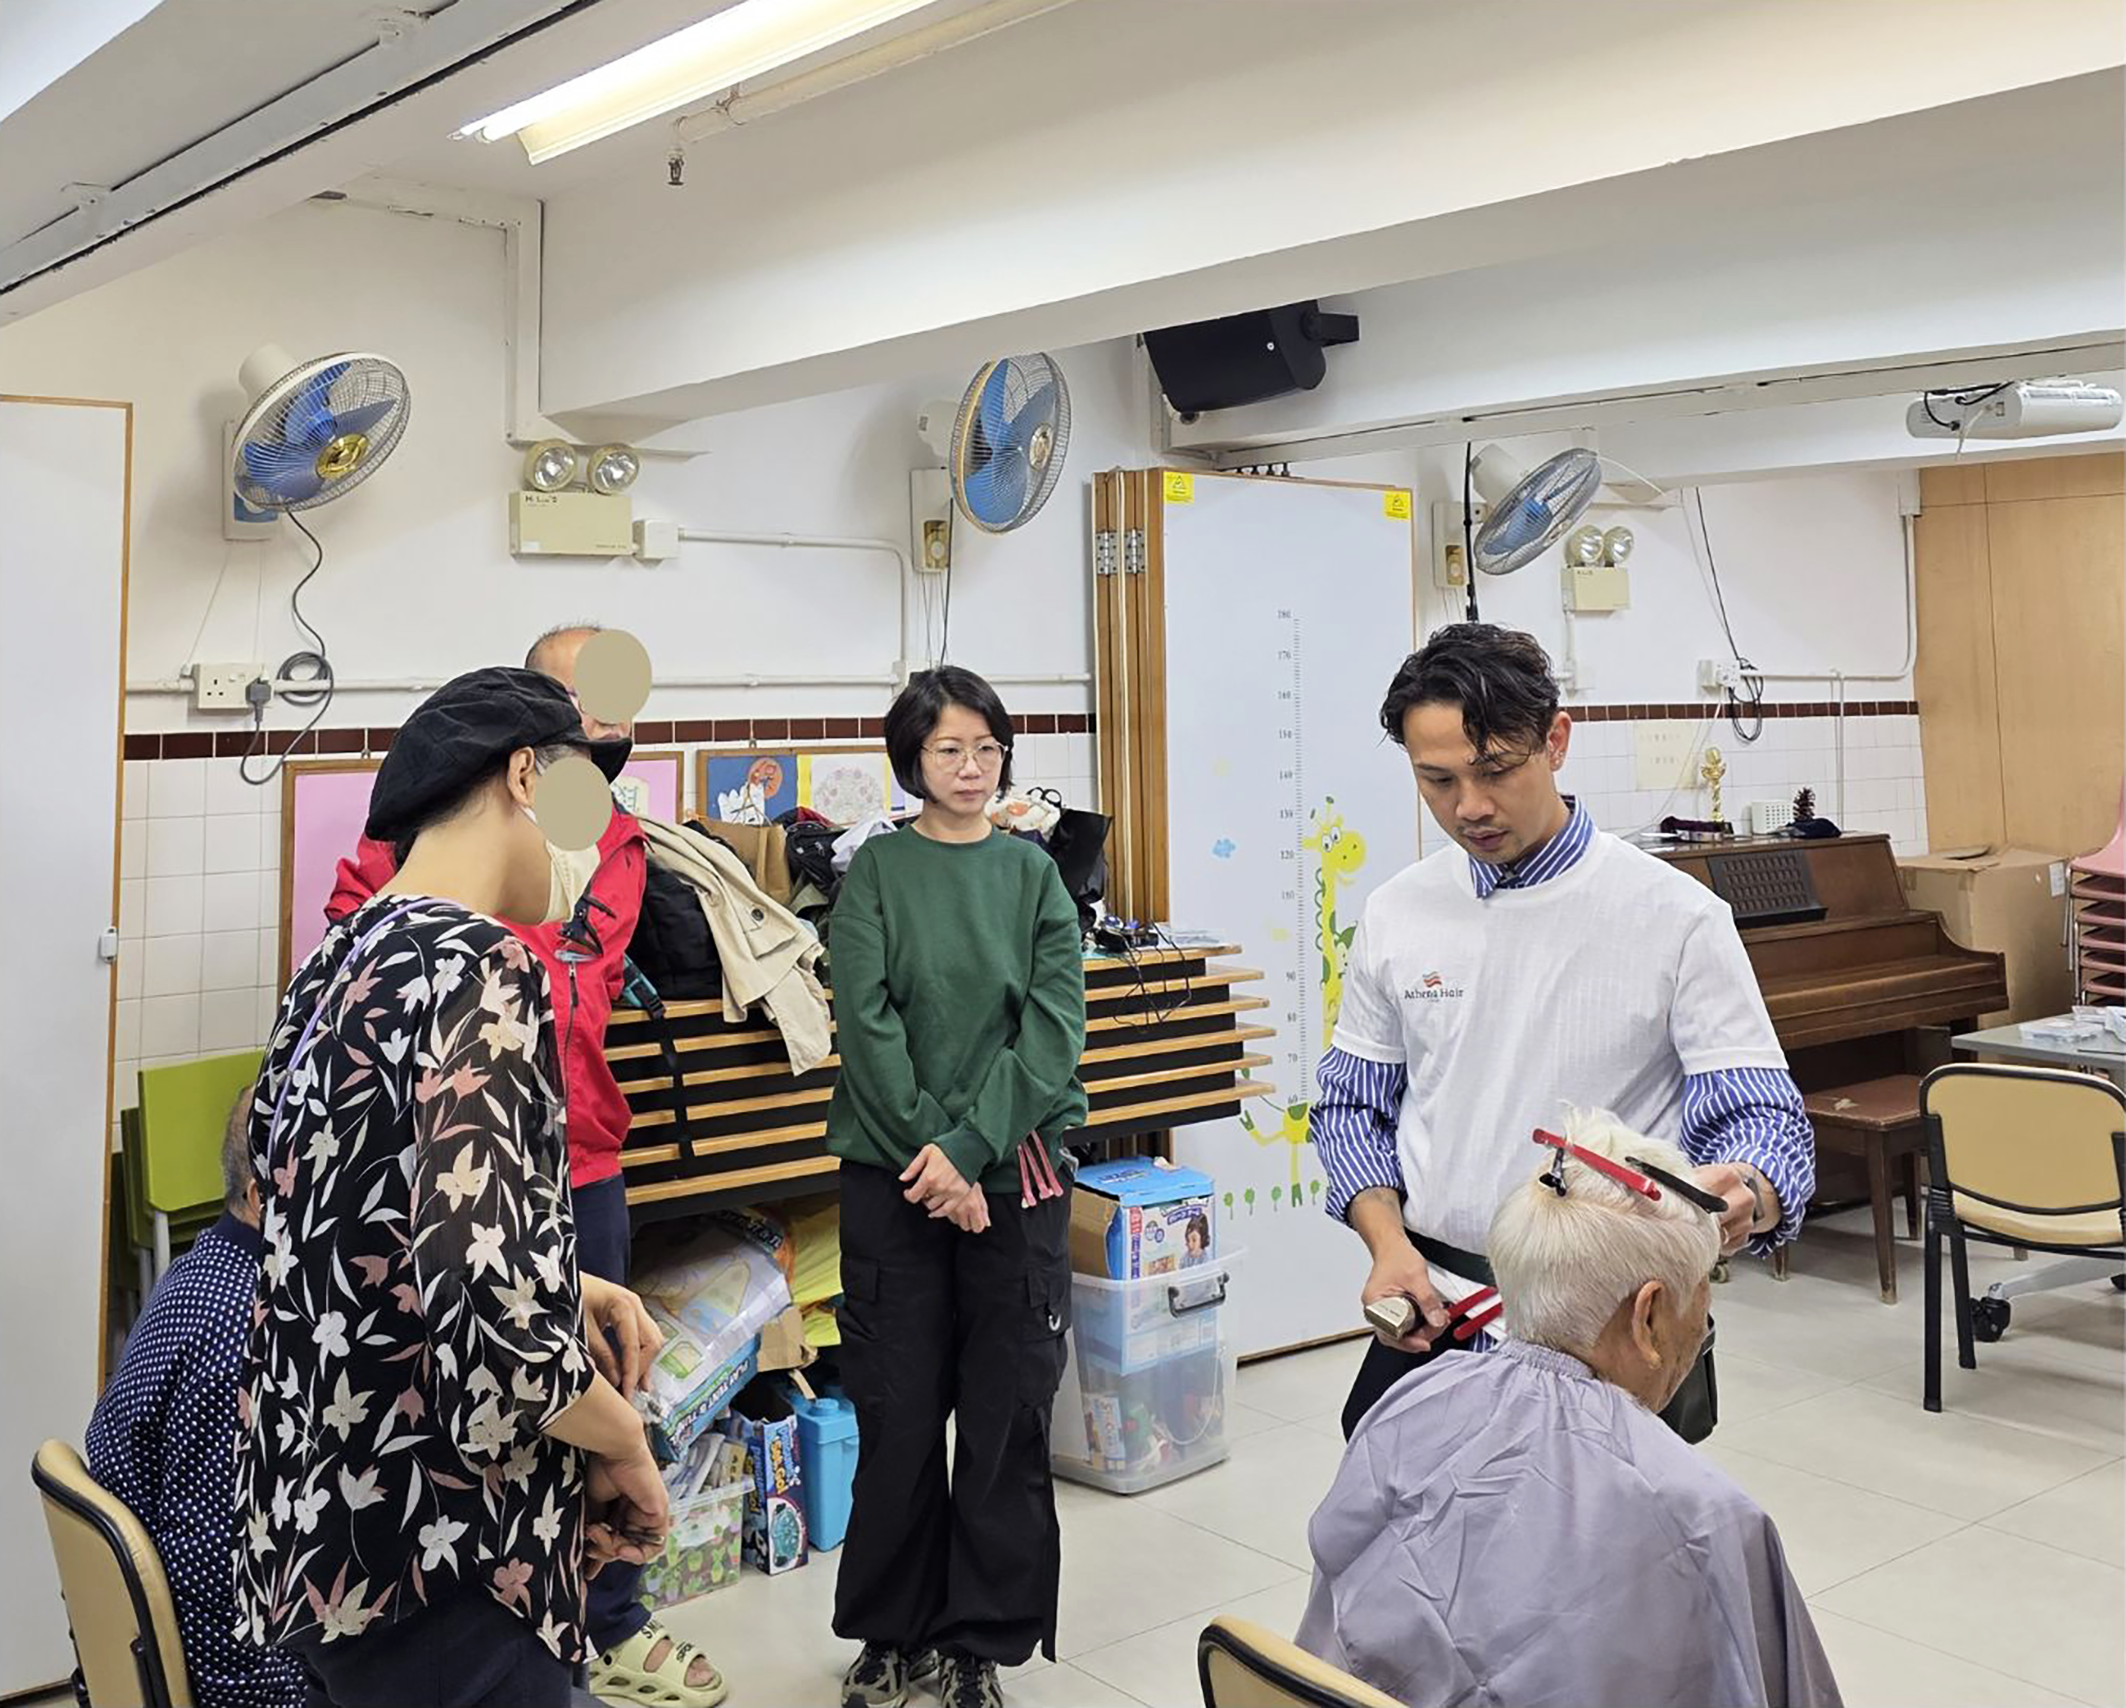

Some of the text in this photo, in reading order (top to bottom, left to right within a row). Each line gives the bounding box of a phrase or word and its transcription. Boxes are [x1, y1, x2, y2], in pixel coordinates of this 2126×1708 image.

[1278, 650, 1291, 660] 170
[1280, 850, 1294, 860] 120
[1404, 987, 1464, 1000] Athena Hair
[1287, 1053, 1298, 1063] 70
